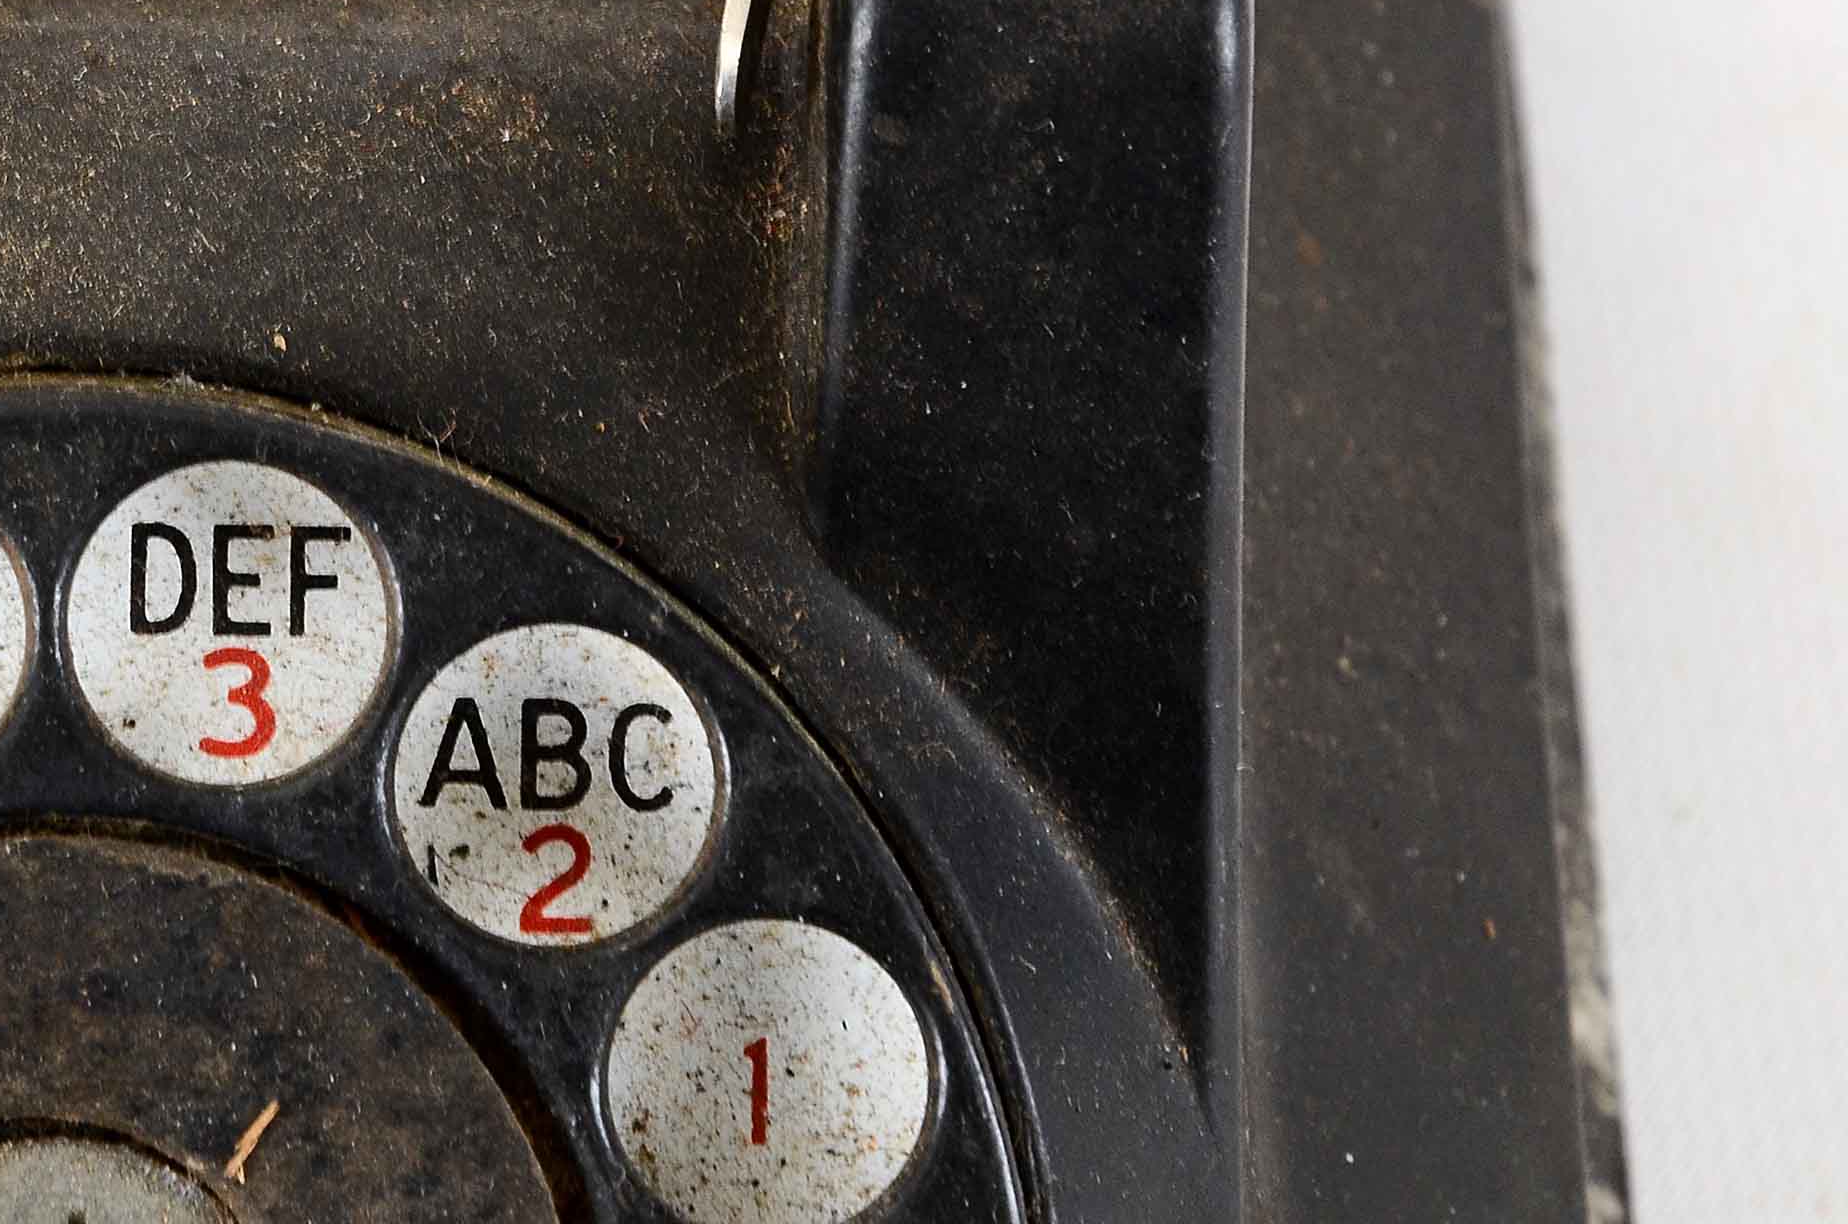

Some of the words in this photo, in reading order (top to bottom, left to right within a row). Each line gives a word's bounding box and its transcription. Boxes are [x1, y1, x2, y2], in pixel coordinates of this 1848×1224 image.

[129, 521, 352, 637] DEF
[198, 646, 277, 760] 3
[417, 697, 674, 814] ABC
[519, 824, 593, 935] 2
[744, 1037, 769, 1145] 1
